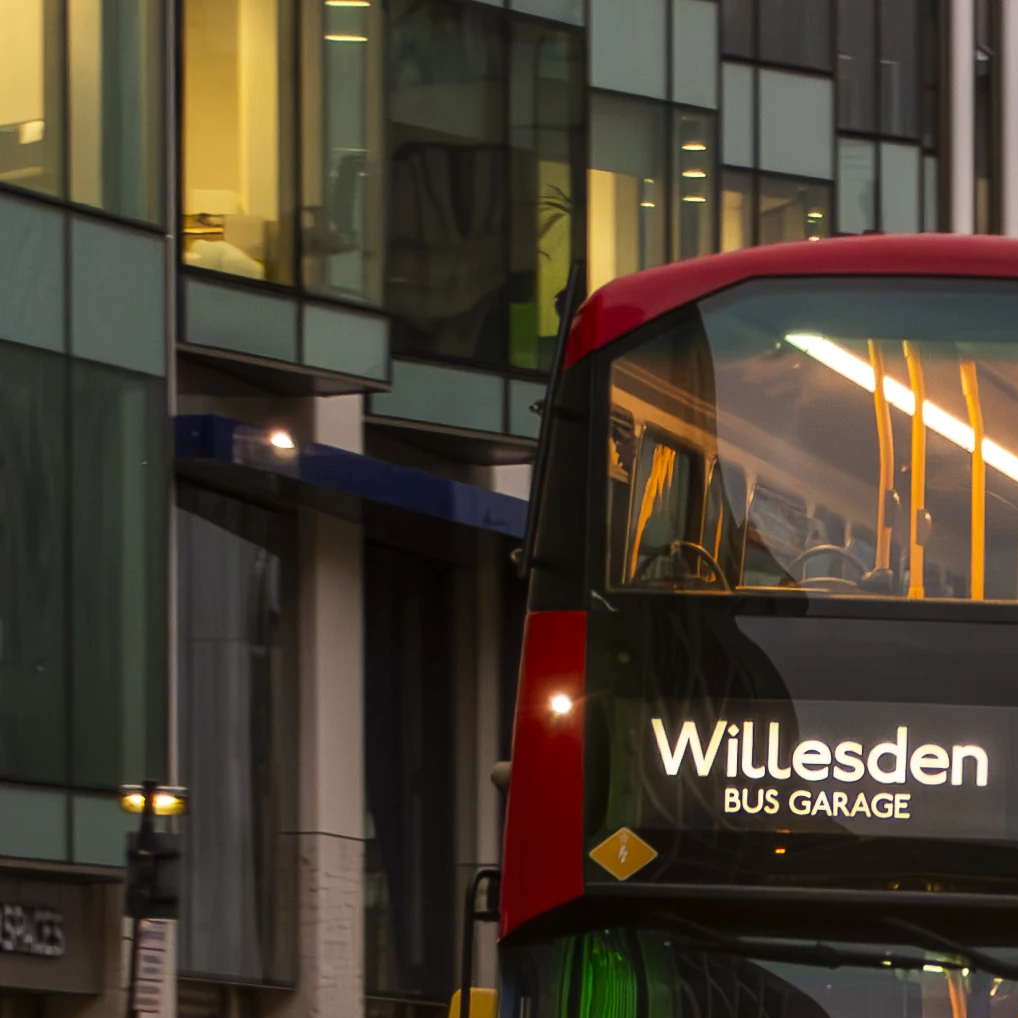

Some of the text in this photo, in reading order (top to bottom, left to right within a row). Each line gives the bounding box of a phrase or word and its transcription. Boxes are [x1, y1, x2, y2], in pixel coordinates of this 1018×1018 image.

[651, 718, 988, 787] Willesden
[724, 787, 911, 819] BUS GARAGE
